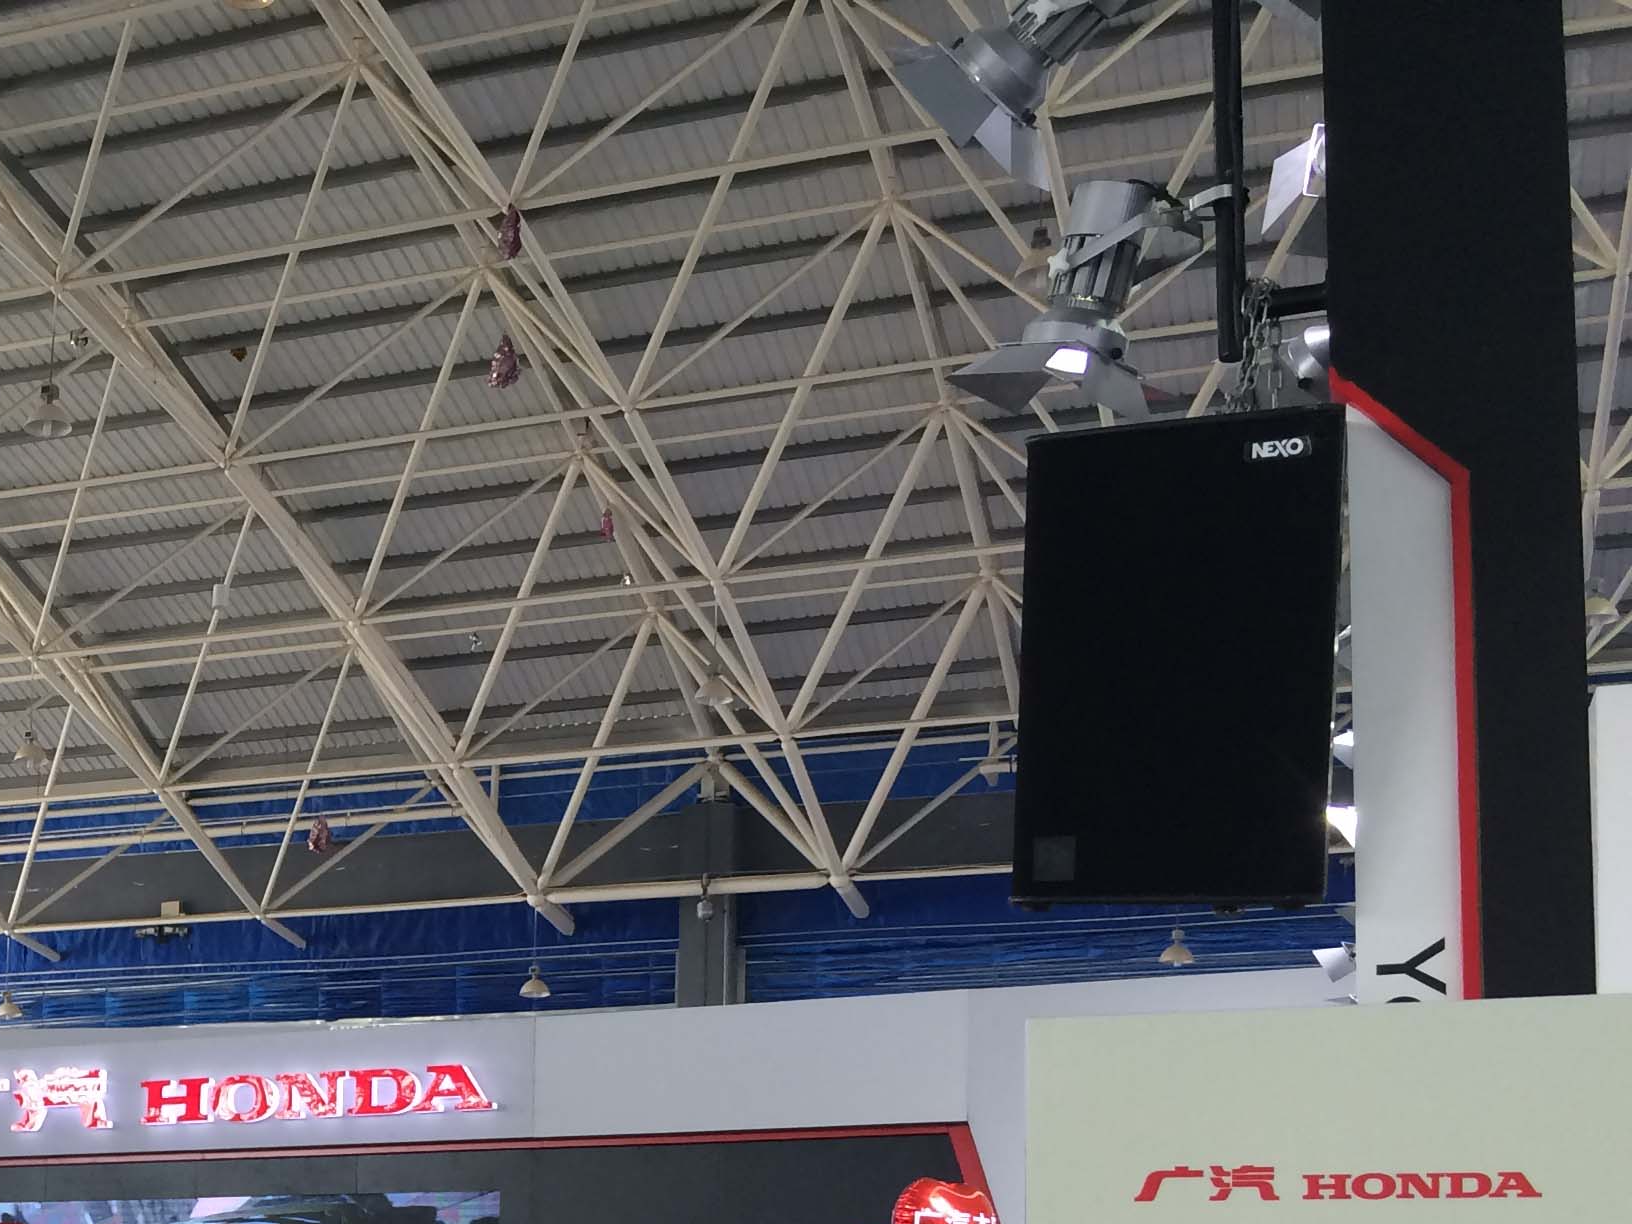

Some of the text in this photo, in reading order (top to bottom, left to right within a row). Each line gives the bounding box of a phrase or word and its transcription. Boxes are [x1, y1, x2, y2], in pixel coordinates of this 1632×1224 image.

[1252, 437, 1304, 458] NEXO
[140, 1063, 499, 1126] HONDA
[1134, 1165, 1543, 1201] 广汽 HONDA
